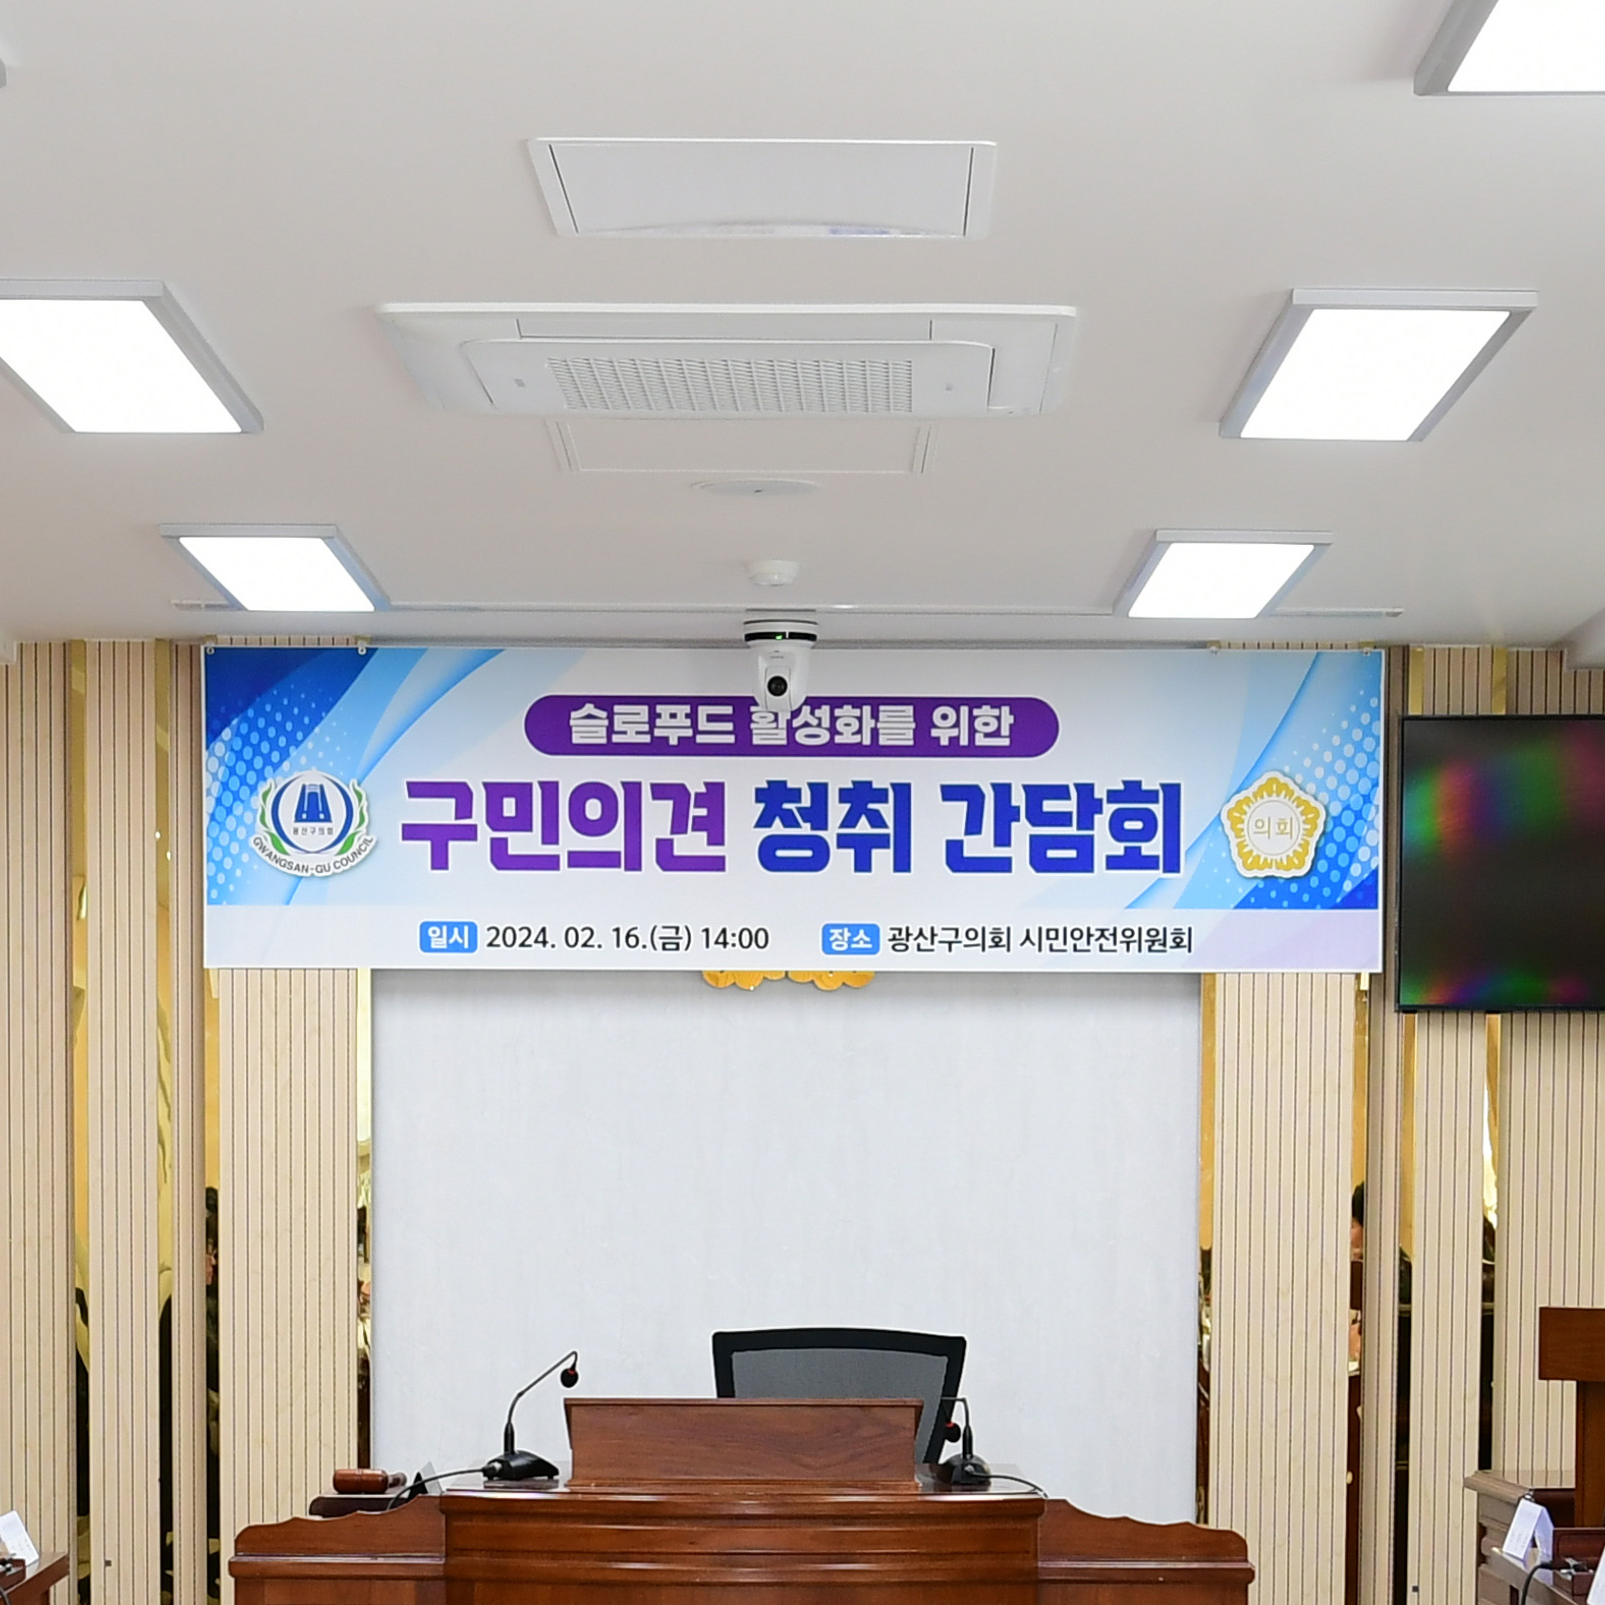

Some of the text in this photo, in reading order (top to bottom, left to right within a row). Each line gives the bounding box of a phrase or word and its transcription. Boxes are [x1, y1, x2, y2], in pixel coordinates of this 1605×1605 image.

[568, 702, 1014, 747] 슬로푸드 활성화를 위한
[401, 780, 1182, 873] 구민의견 청취 간담회
[1252, 817, 1295, 841] 의회
[253, 836, 374, 874] GWANGSAN-GU COUNCIL
[427, 925, 770, 951] 일시 2024. 02. 16.(금) 14:00
[829, 926, 1193, 953] 장소 광산구의회 시민안전위원회
